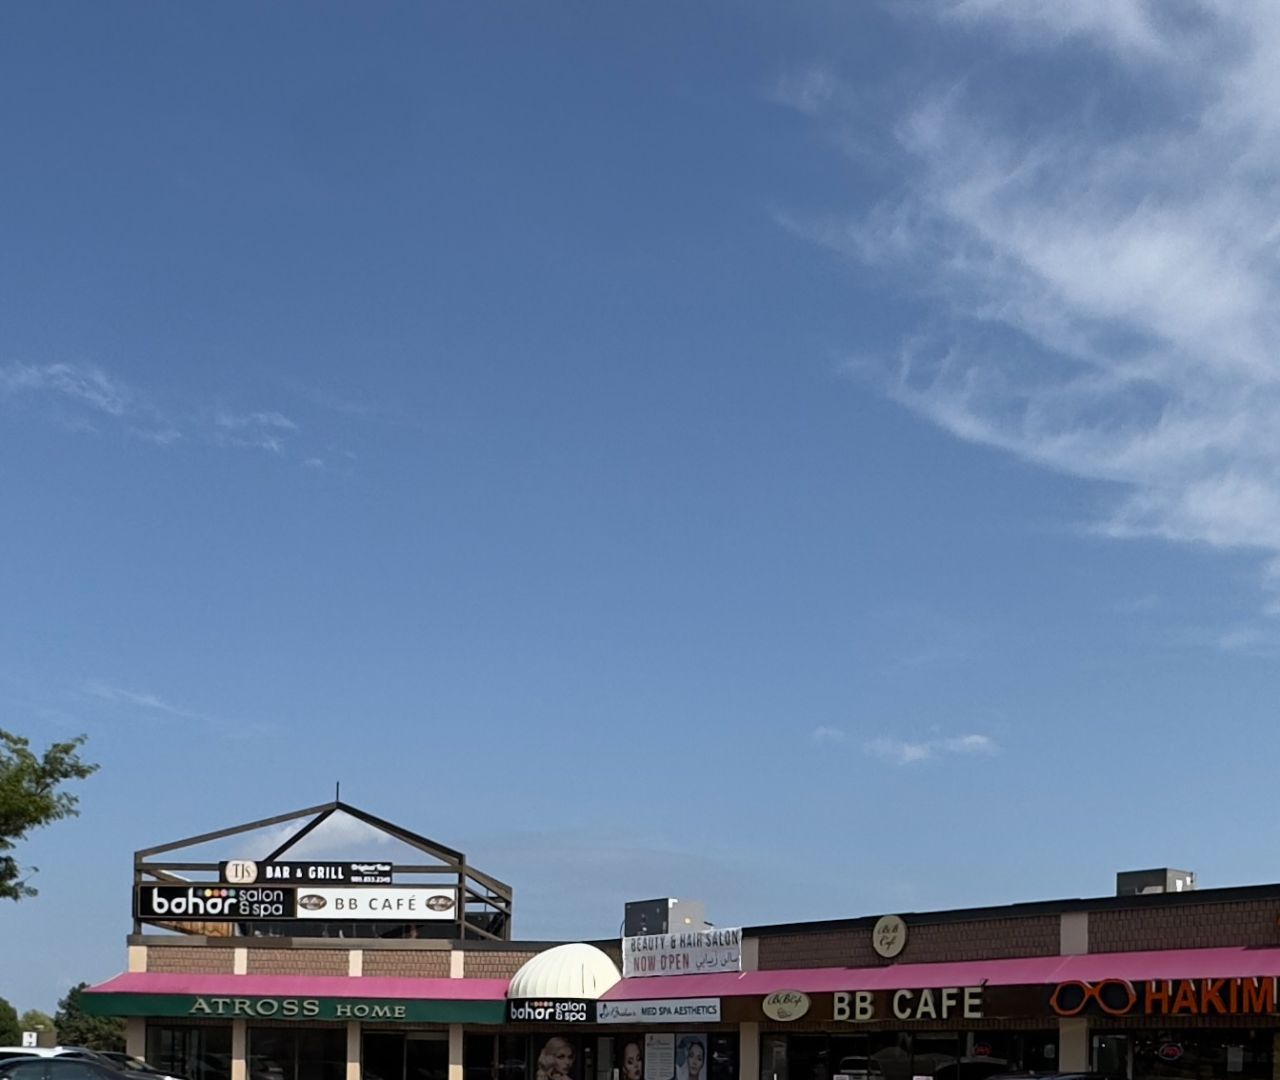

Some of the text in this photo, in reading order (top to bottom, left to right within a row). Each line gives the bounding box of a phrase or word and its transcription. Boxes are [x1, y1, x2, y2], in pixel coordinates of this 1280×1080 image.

[265, 866, 345, 879] BAR & GRILL
[152, 888, 283, 914] bahar salon
[252, 903, 283, 917] spa
[335, 897, 359, 910] BB
[369, 895, 416, 911] CAFÉ
[631, 936, 666, 952] BEAUTY
[680, 932, 703, 948] HAIR
[705, 929, 740, 947] SALON
[633, 953, 690, 972] NOW OPEN
[833, 987, 985, 1021] BB CAFE
[1144, 975, 1278, 1015] HAKIM
[189, 996, 407, 1018] ATROSS HOME
[510, 1001, 555, 1020] bahar
[555, 1001, 587, 1012] salon
[641, 1007, 657, 1016] MED
[659, 1006, 673, 1016] SPA
[673, 1005, 718, 1015] AESTHETICS
[564, 1012, 587, 1022] spa
